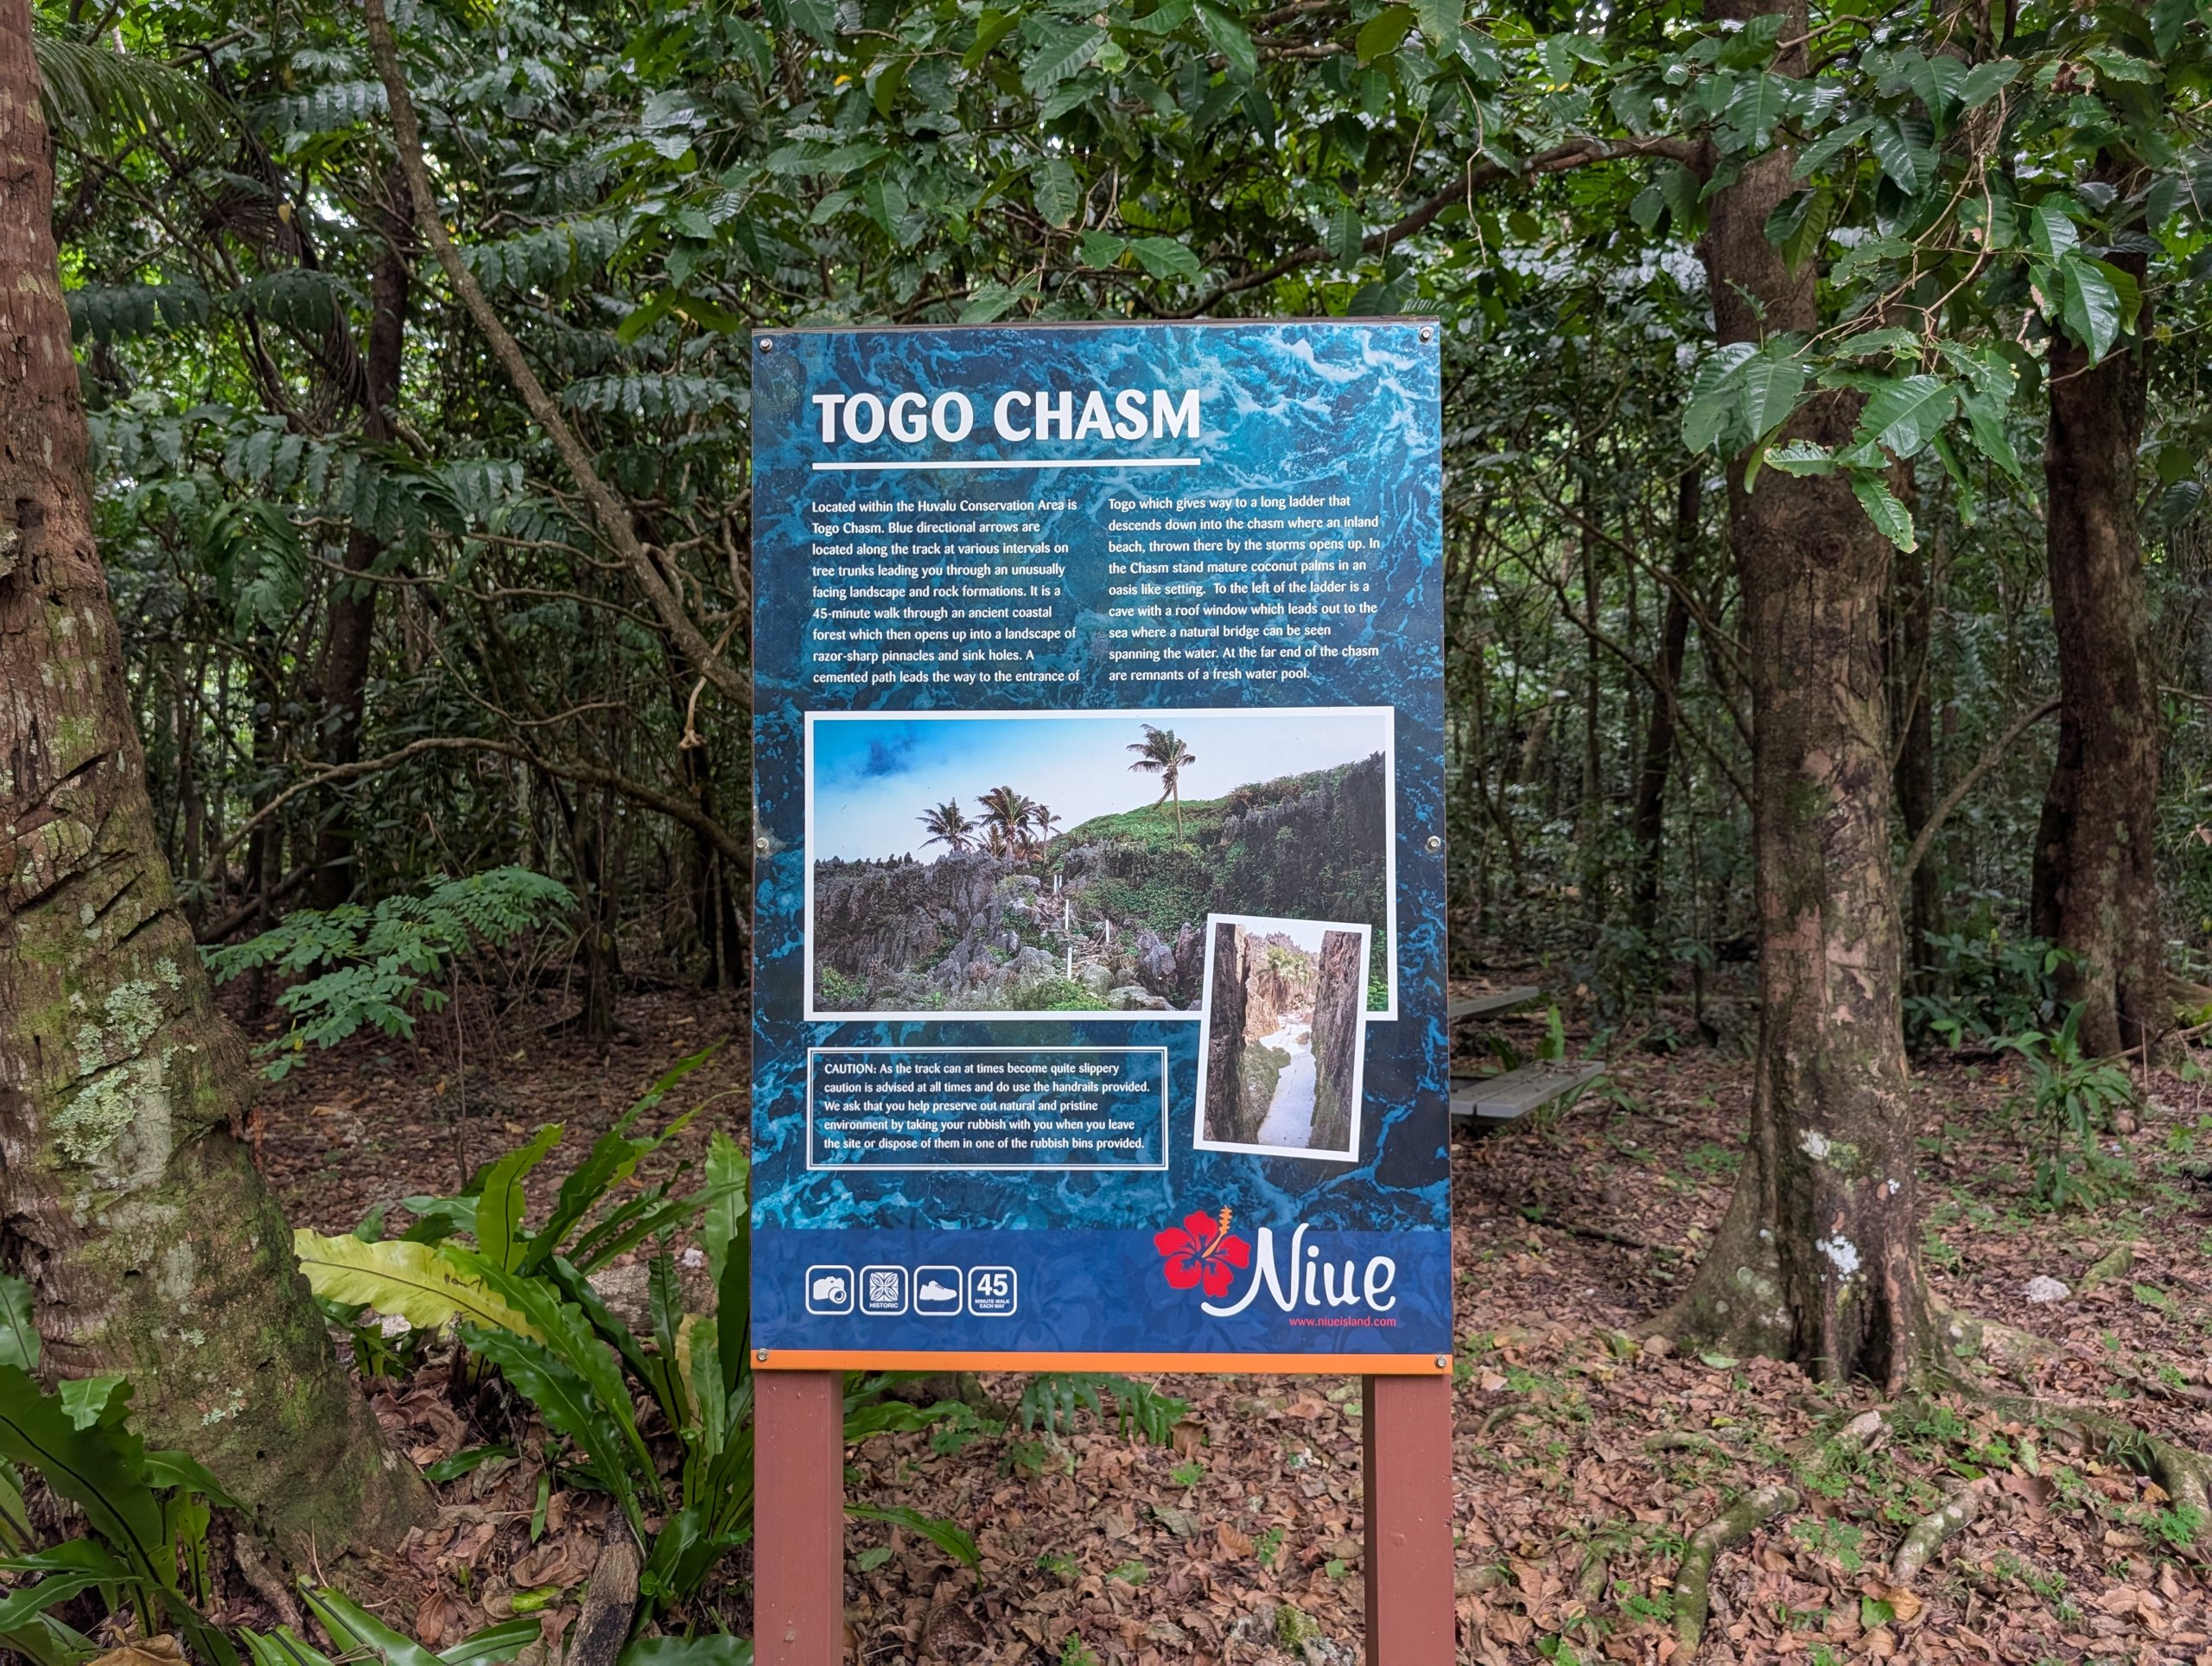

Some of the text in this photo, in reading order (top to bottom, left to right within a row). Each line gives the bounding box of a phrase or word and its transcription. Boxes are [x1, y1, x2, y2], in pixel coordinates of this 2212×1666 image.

[811, 389, 1201, 443] TOGO CHASM
[811, 499, 1077, 512] Located within the Huvalu Conservation Area is
[1108, 493, 1351, 512] Togo which gives way to a long ladder that
[811, 520, 1040, 537] Togo Chasm. Blue directional arrows are
[1108, 515, 1379, 531] descends down into the chasm where an inland
[811, 541, 1069, 558] located along the track at various intervals on
[1108, 537, 1380, 554] beach, thrown there by the storms opens up. In
[811, 563, 1065, 579] tree trunks leading you through an unusually
[1108, 558, 1367, 574] the Chasm stand mature coconut palms in an
[812, 605, 1052, 621] 45-minute walk through an ancient coastal
[1108, 623, 1331, 639] sea where a natural bridge can be seen
[812, 648, 1034, 664] razor-sharp pinnacles and sink holes. A
[812, 669, 1080, 685] cemented path leads the way to the entrance of
[1108, 665, 1310, 682] are remnants of a fresh water pool.
[823, 1061, 1120, 1076] CAUTION: As the track can at times become quite slippery
[823, 1080, 1149, 1095] caution is advised at all times and do use the handrails provided.
[823, 1099, 1098, 1114] We ask that you help preserve out natural and pristine
[823, 1117, 1135, 1133] environment by taking your rubbish with you when you leave
[1200, 1223, 1396, 1317] Niue
[976, 1274, 1008, 1296] 45
[1288, 1316, 1396, 1327] www.niueisland.com
